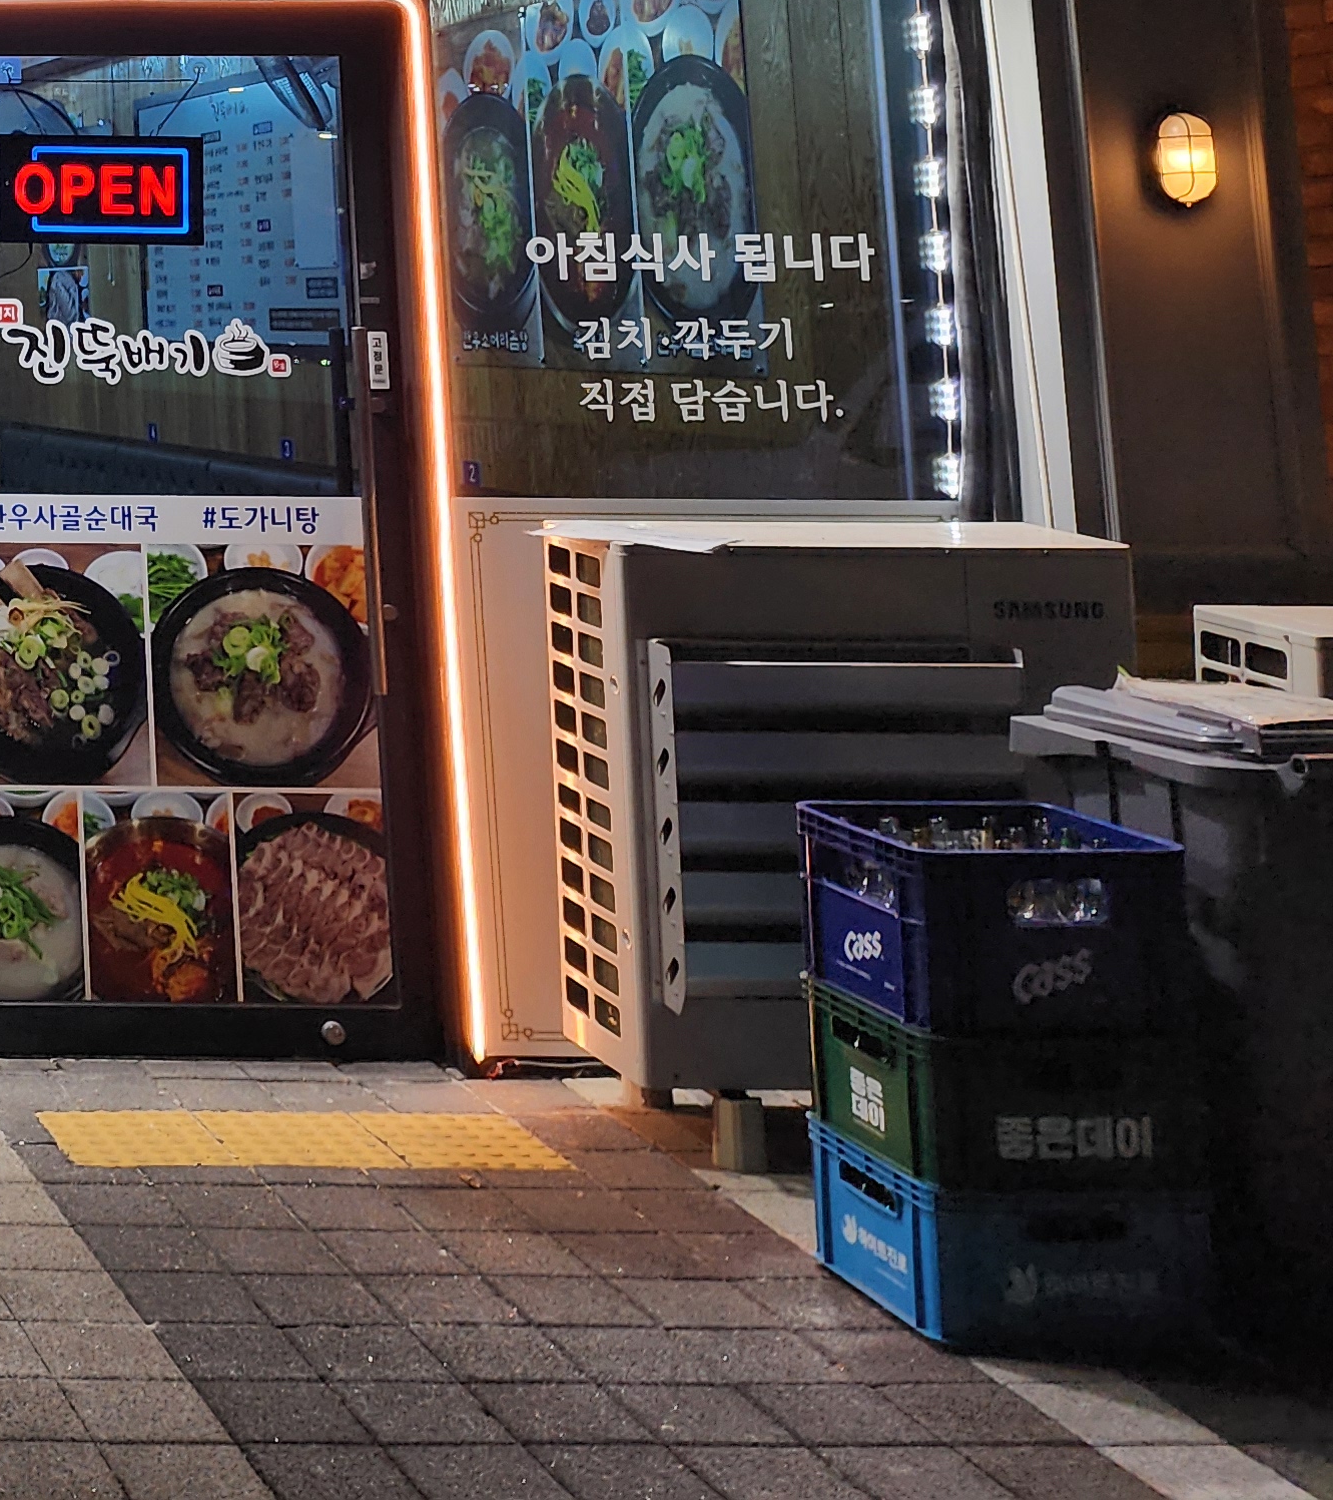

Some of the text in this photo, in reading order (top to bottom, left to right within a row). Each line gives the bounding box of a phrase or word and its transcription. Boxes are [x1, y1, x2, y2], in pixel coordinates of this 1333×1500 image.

[14, 162, 177, 217] OPEN
[525, 232, 875, 283] 아침식사 됩니다
[4, 320, 208, 382] 진뚝배기
[372, 337, 383, 375] 고정문
[579, 379, 845, 423] 직접 담습니다.
[201, 504, 320, 535] #도가니탕
[993, 600, 1105, 620] SAMSUNG
[995, 1115, 1152, 1160] 좋은데이
